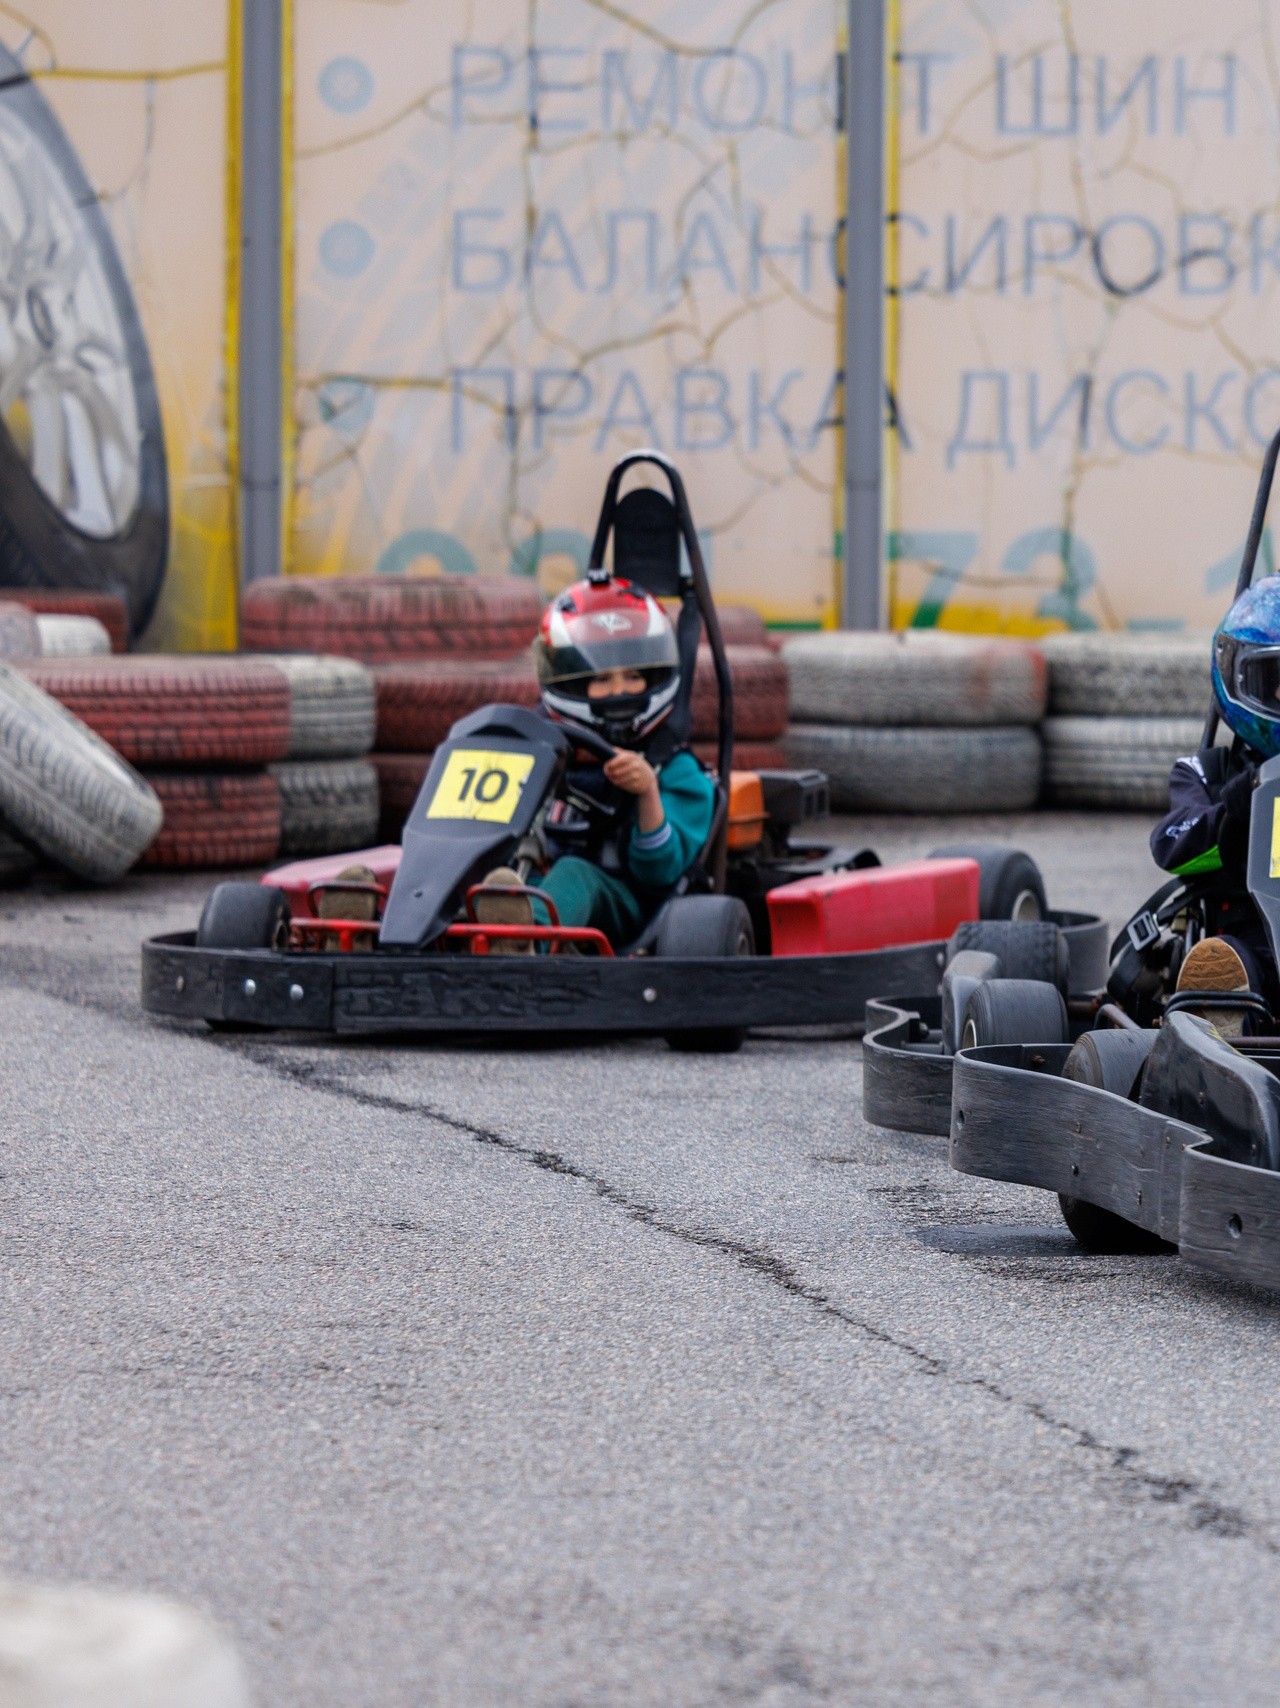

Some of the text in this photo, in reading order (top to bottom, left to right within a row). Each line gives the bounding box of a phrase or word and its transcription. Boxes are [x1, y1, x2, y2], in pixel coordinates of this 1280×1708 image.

[450, 44, 957, 135] РЕМОНТ
[993, 52, 1239, 138] ШИН
[449, 367, 914, 455] ПРАВКА
[457, 768, 509, 803] 10
